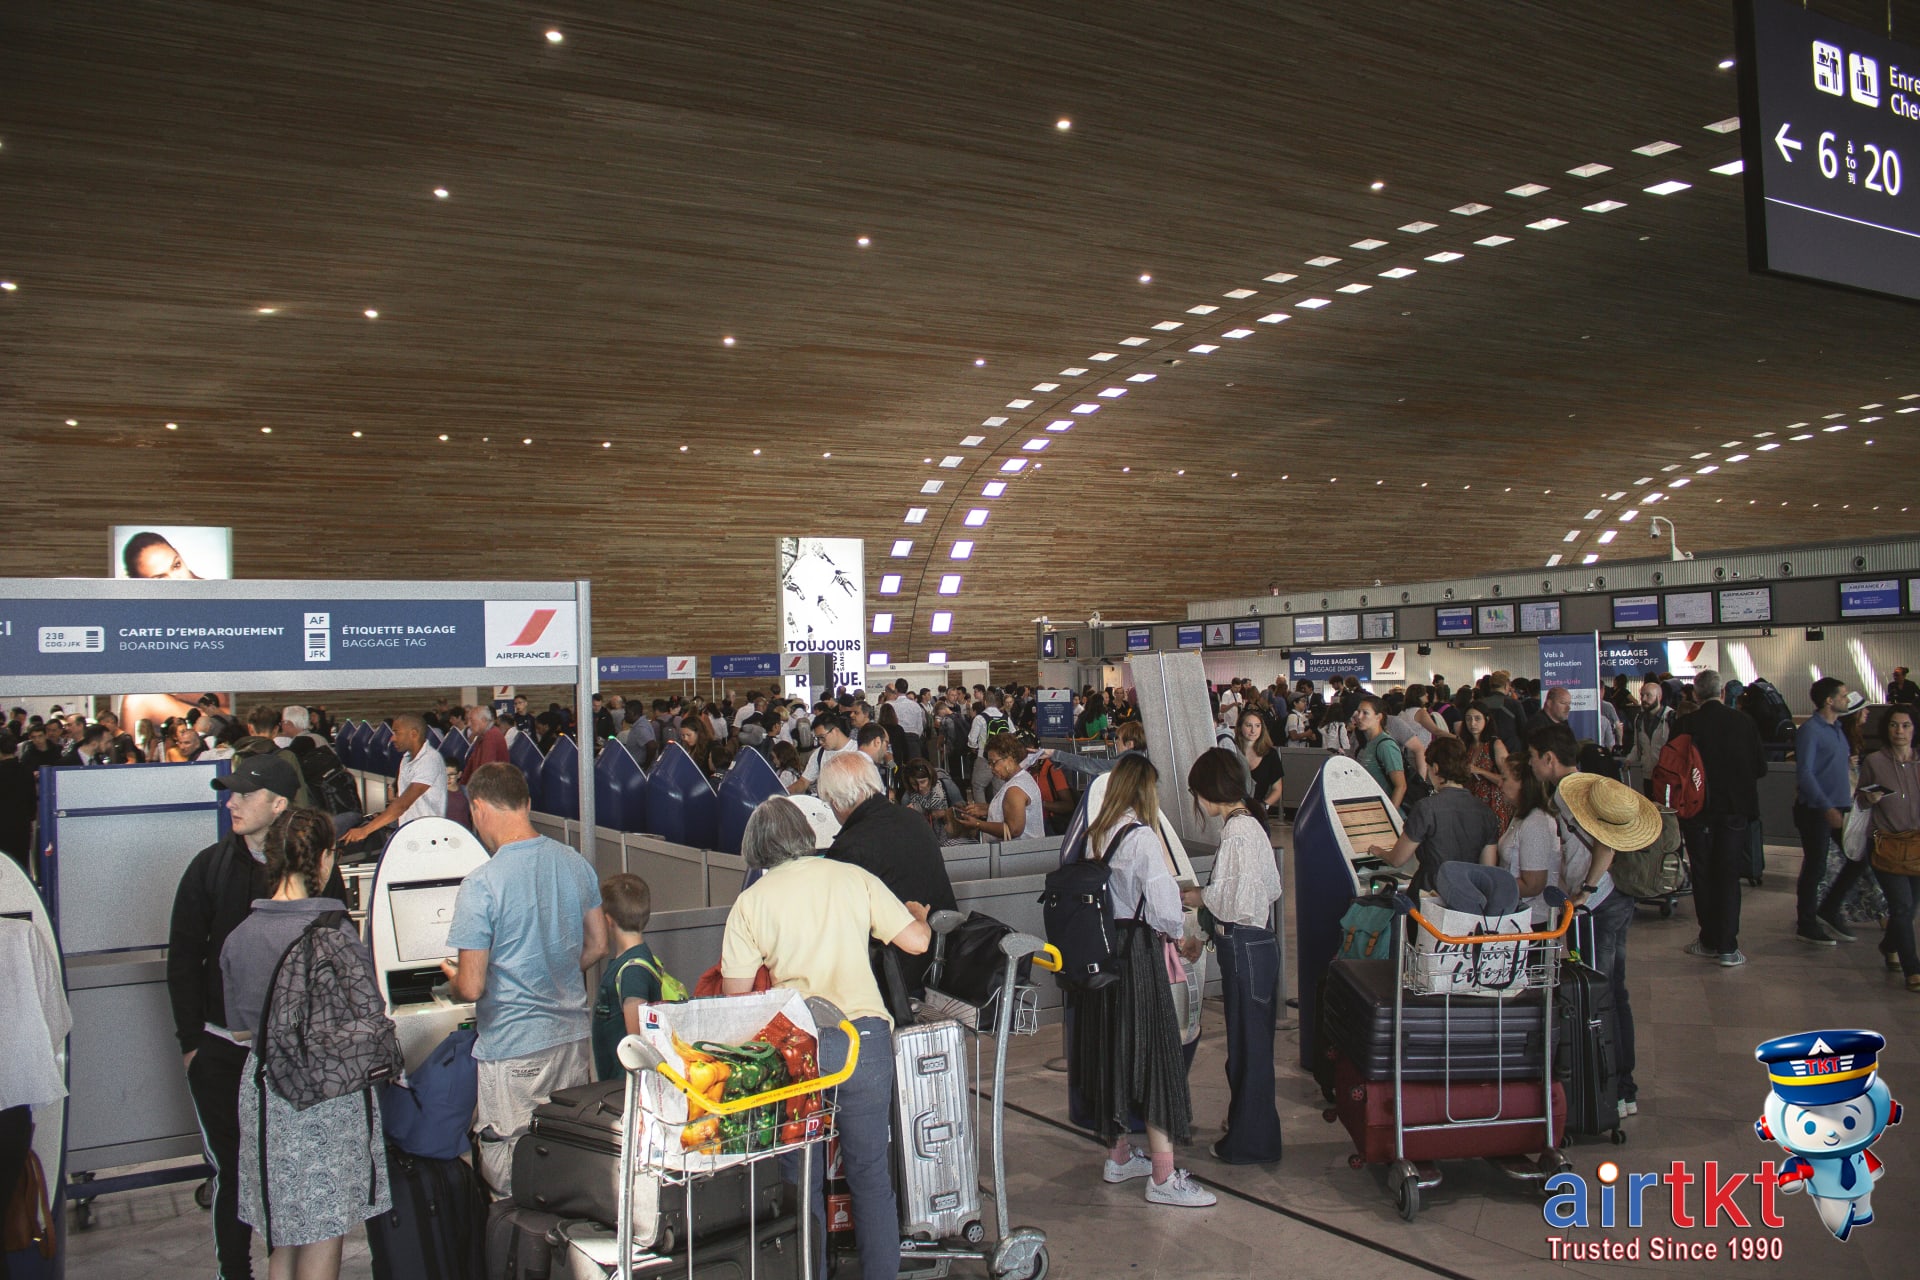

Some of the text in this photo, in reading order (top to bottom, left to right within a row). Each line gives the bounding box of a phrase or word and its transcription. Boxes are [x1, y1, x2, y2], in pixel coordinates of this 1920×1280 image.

[1818, 131, 1901, 196] 6 à 20
[1845, 156, 1856, 170] to
[309, 616, 325, 625] AF
[118, 626, 286, 637] CARTE D'EMBARQUEMENT
[342, 625, 456, 635] ÉTIQUETTE BAGAGE
[45, 632, 65, 640] 23B
[119, 640, 225, 651] BOARDING PASS
[342, 638, 427, 648] BAGGAGE TAG
[788, 640, 861, 652] TOUJOURS
[1044, 639, 1052, 653] 4
[309, 650, 326, 658] JFK
[495, 651, 551, 659] AIRFRANCE
[1559, 650, 1564, 658] à
[1609, 649, 1648, 657] BAGAGES
[1309, 658, 1330, 666] DÉPOSE
[1543, 660, 1582, 668] destination
[1618, 658, 1659, 667] DROP-OFF
[1337, 665, 1366, 673] DROP-OFF
